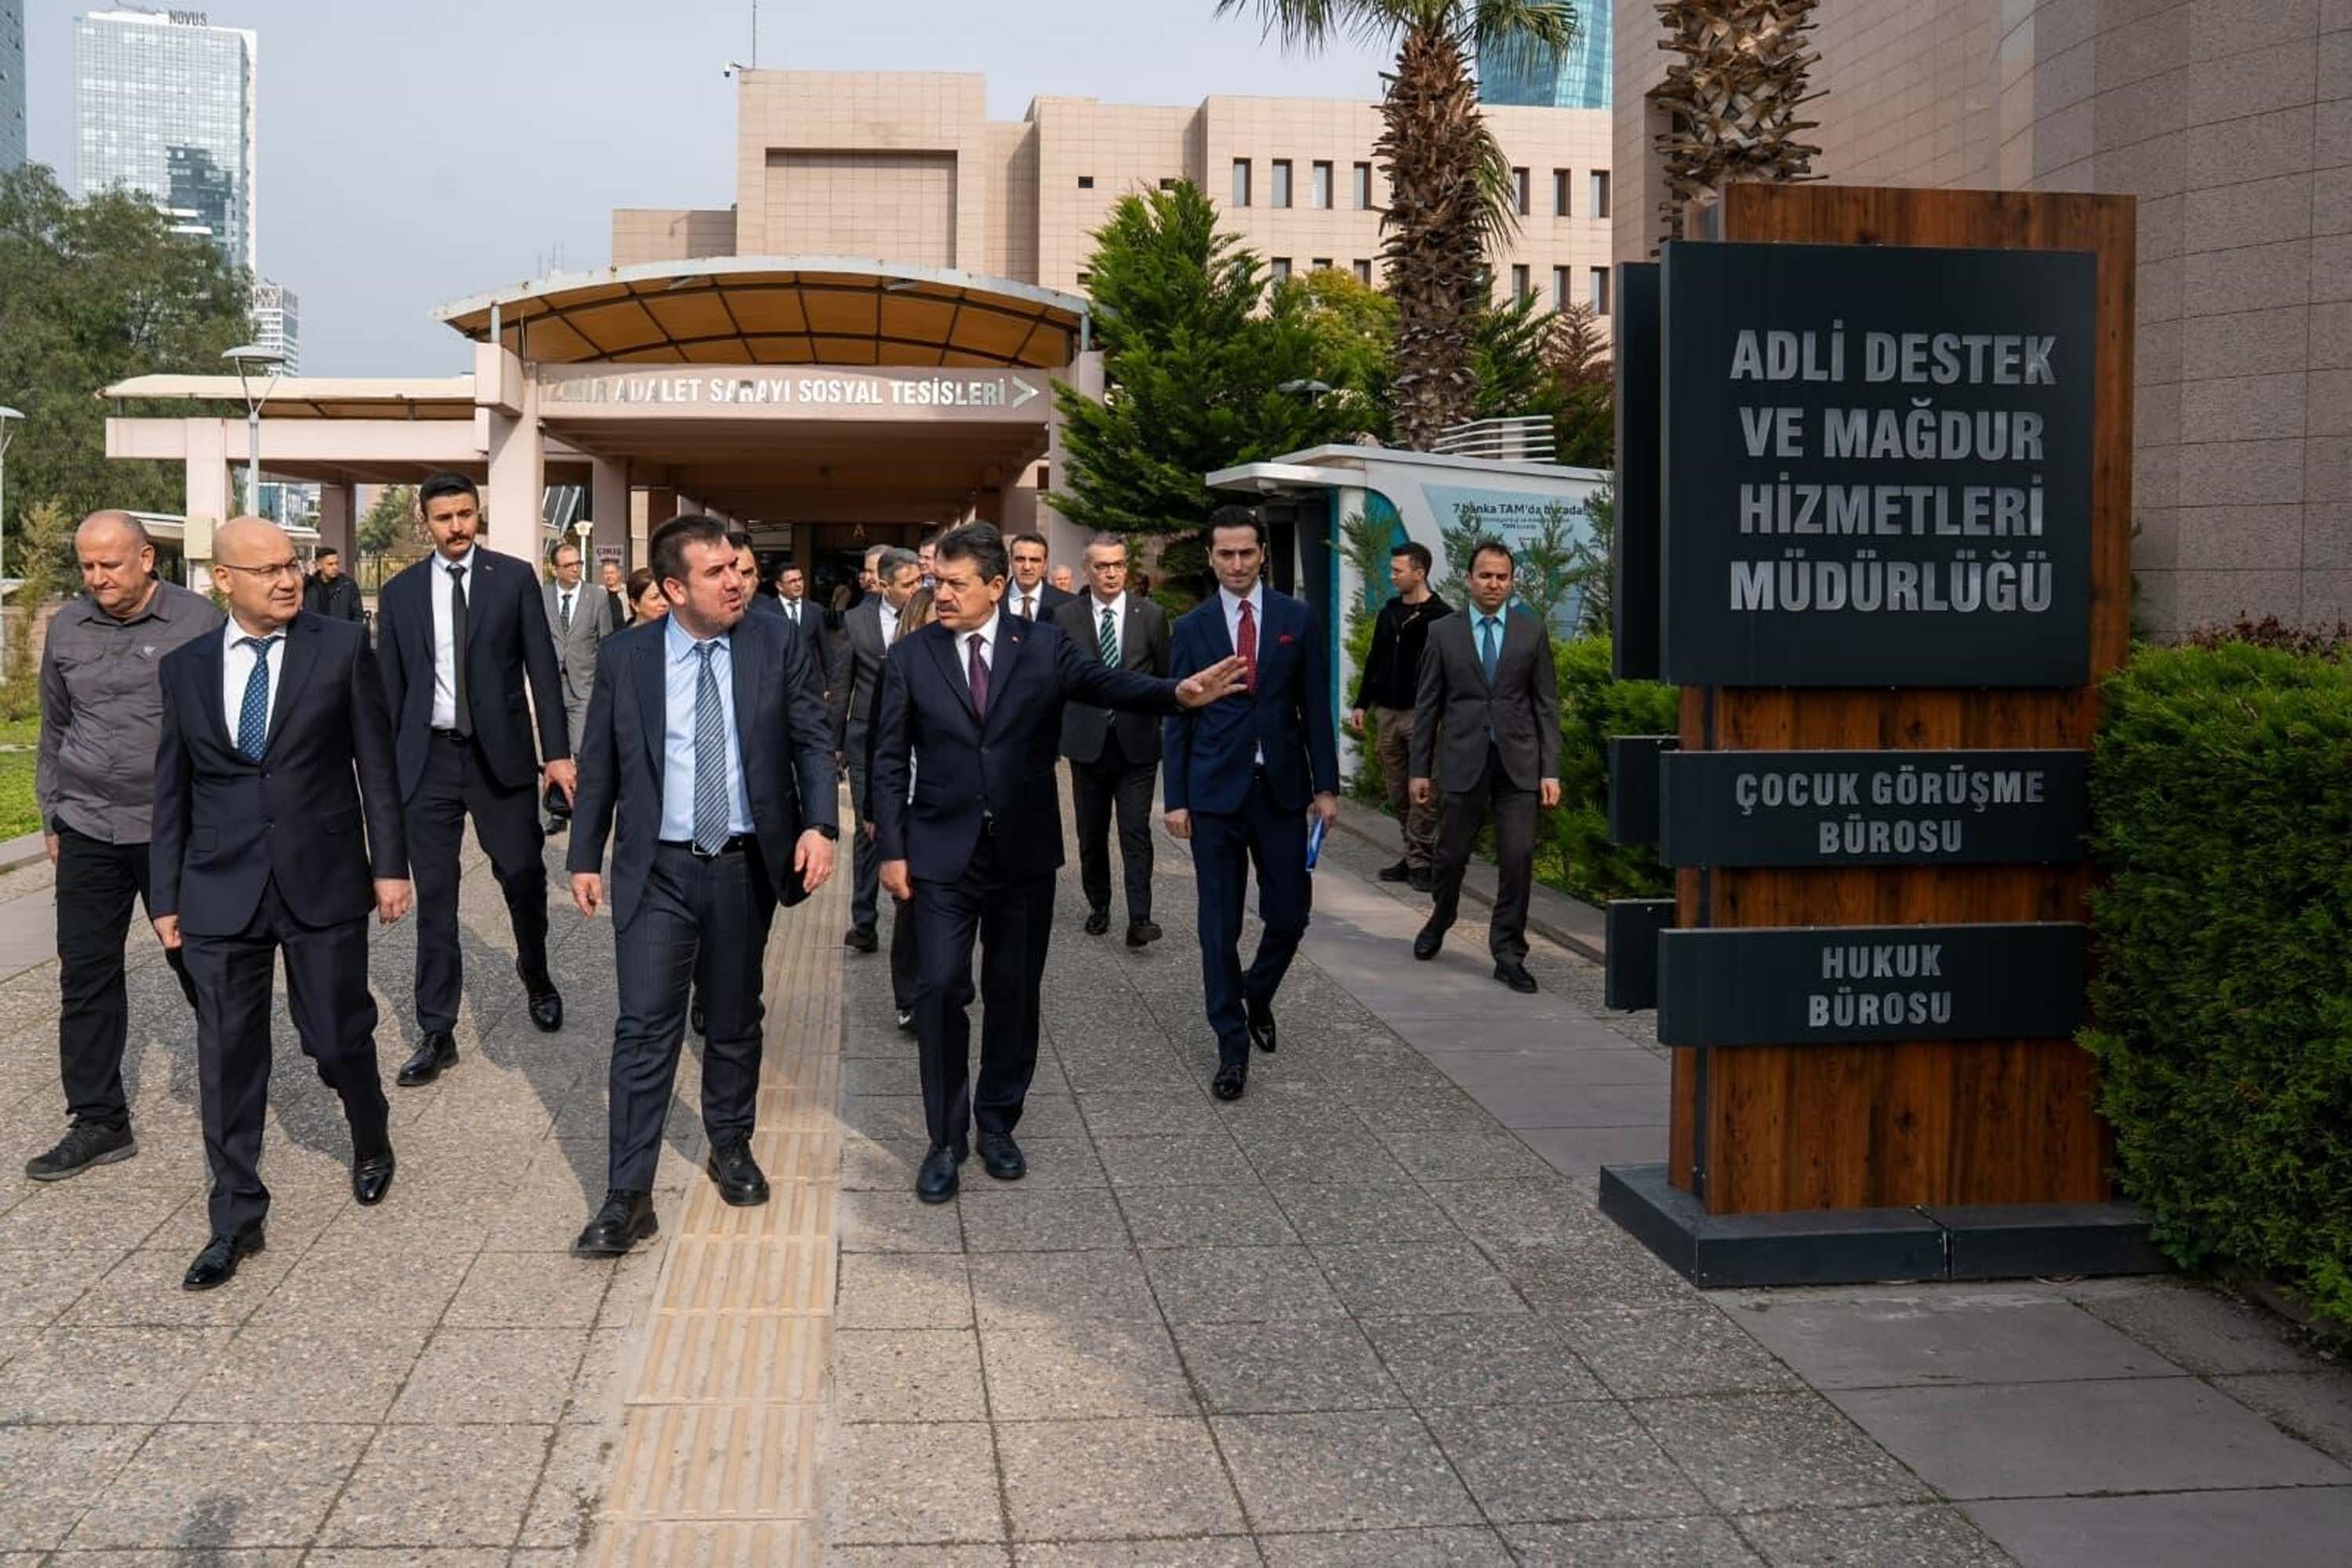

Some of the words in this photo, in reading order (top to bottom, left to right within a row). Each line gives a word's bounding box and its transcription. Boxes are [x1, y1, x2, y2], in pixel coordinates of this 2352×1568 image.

[169, 10, 207, 27] NOVUS
[1730, 319, 1845, 382] ADLİ
[1865, 332, 2058, 385] DESTEK
[614, 378, 702, 402] ADALET
[710, 378, 791, 403] SARAYI
[799, 379, 883, 405] SOSYAL
[891, 376, 1006, 405] TESİSLERİ
[1739, 407, 1803, 458] VE
[1824, 397, 2045, 461] MAĞDUR
[1740, 471, 2045, 537] HİZMETLERİ
[1730, 548, 2053, 612] MÜDÜRLÜĞÜ
[1736, 773, 1860, 815] ÇOCUK
[1871, 764, 2045, 813] GÖRÜŞME
[1819, 813, 1962, 854] BÜROSU
[1822, 945, 1943, 978] HUKUK
[1809, 986, 1951, 1026] BÜROSU
